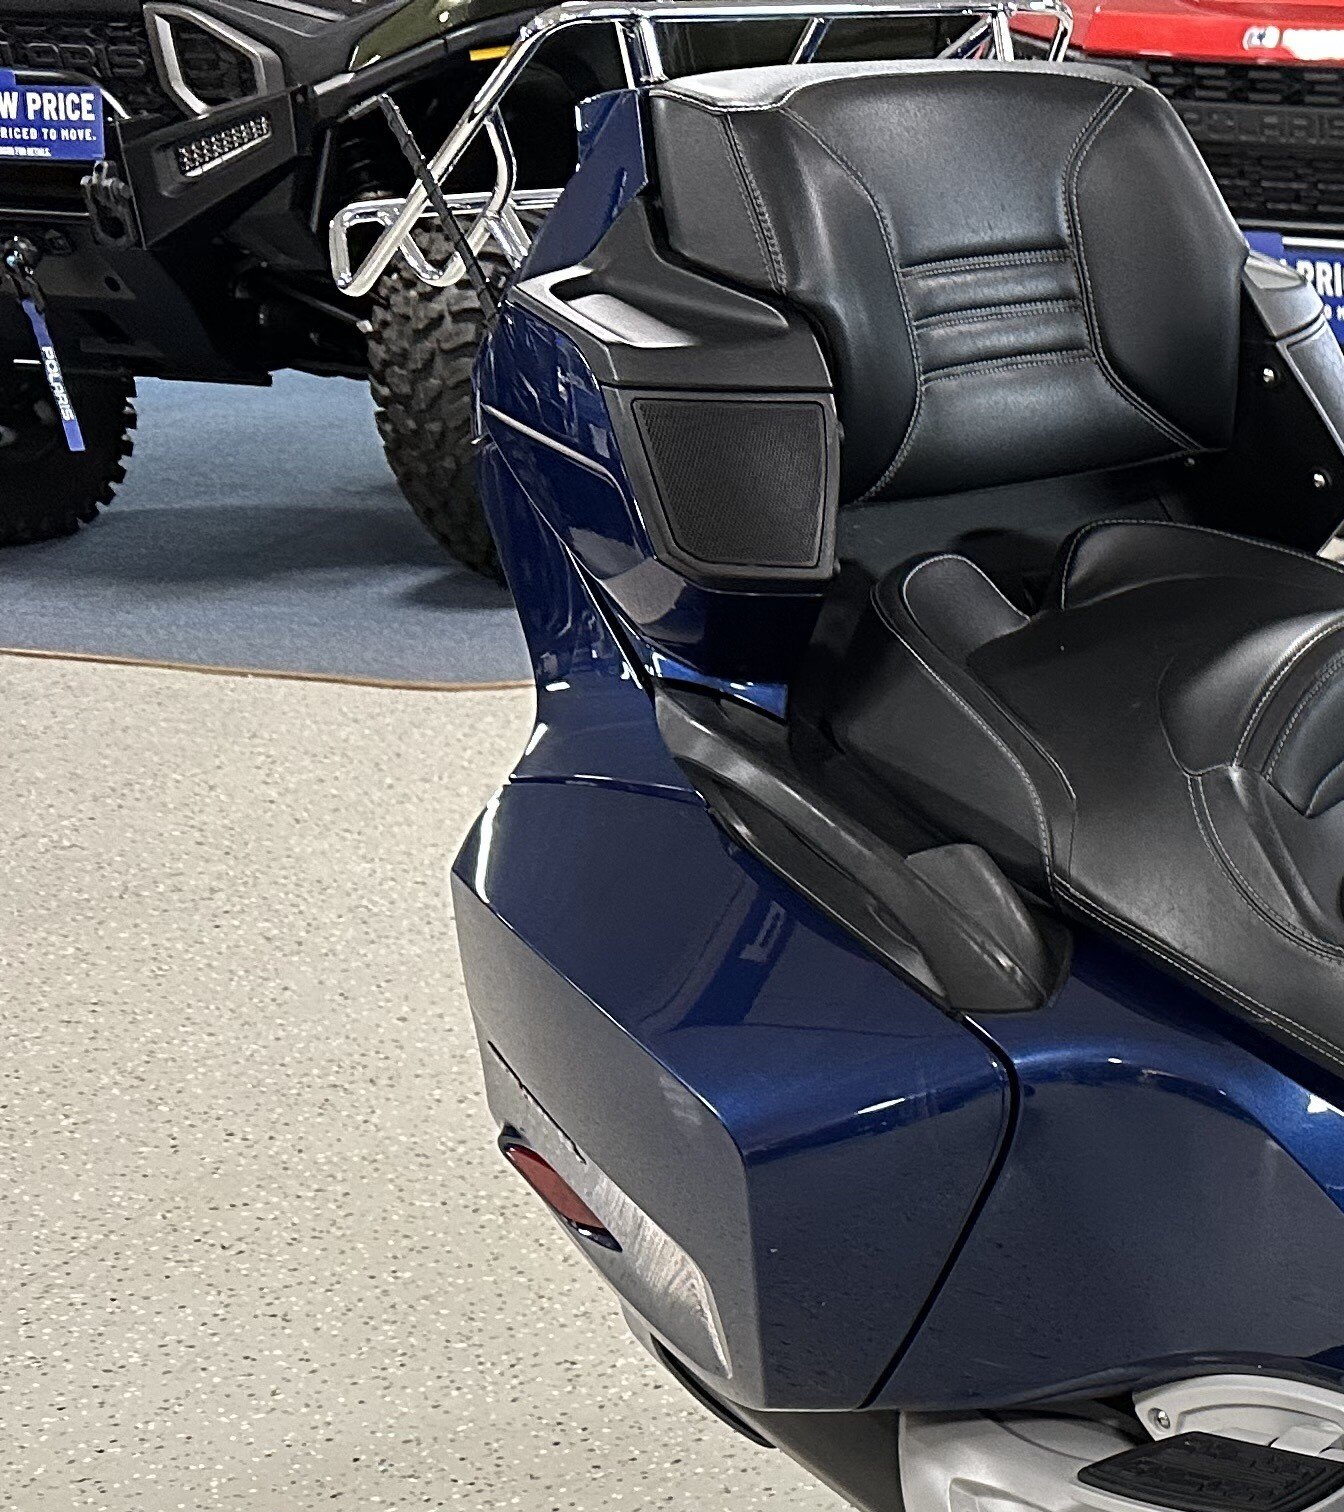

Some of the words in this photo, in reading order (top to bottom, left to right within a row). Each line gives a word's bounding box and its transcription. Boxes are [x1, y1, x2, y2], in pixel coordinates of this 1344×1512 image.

[26, 92, 95, 121] PRICE
[0, 127, 38, 140] RICED
[42, 128, 57, 141] TO
[41, 346, 75, 421] POLARIS
